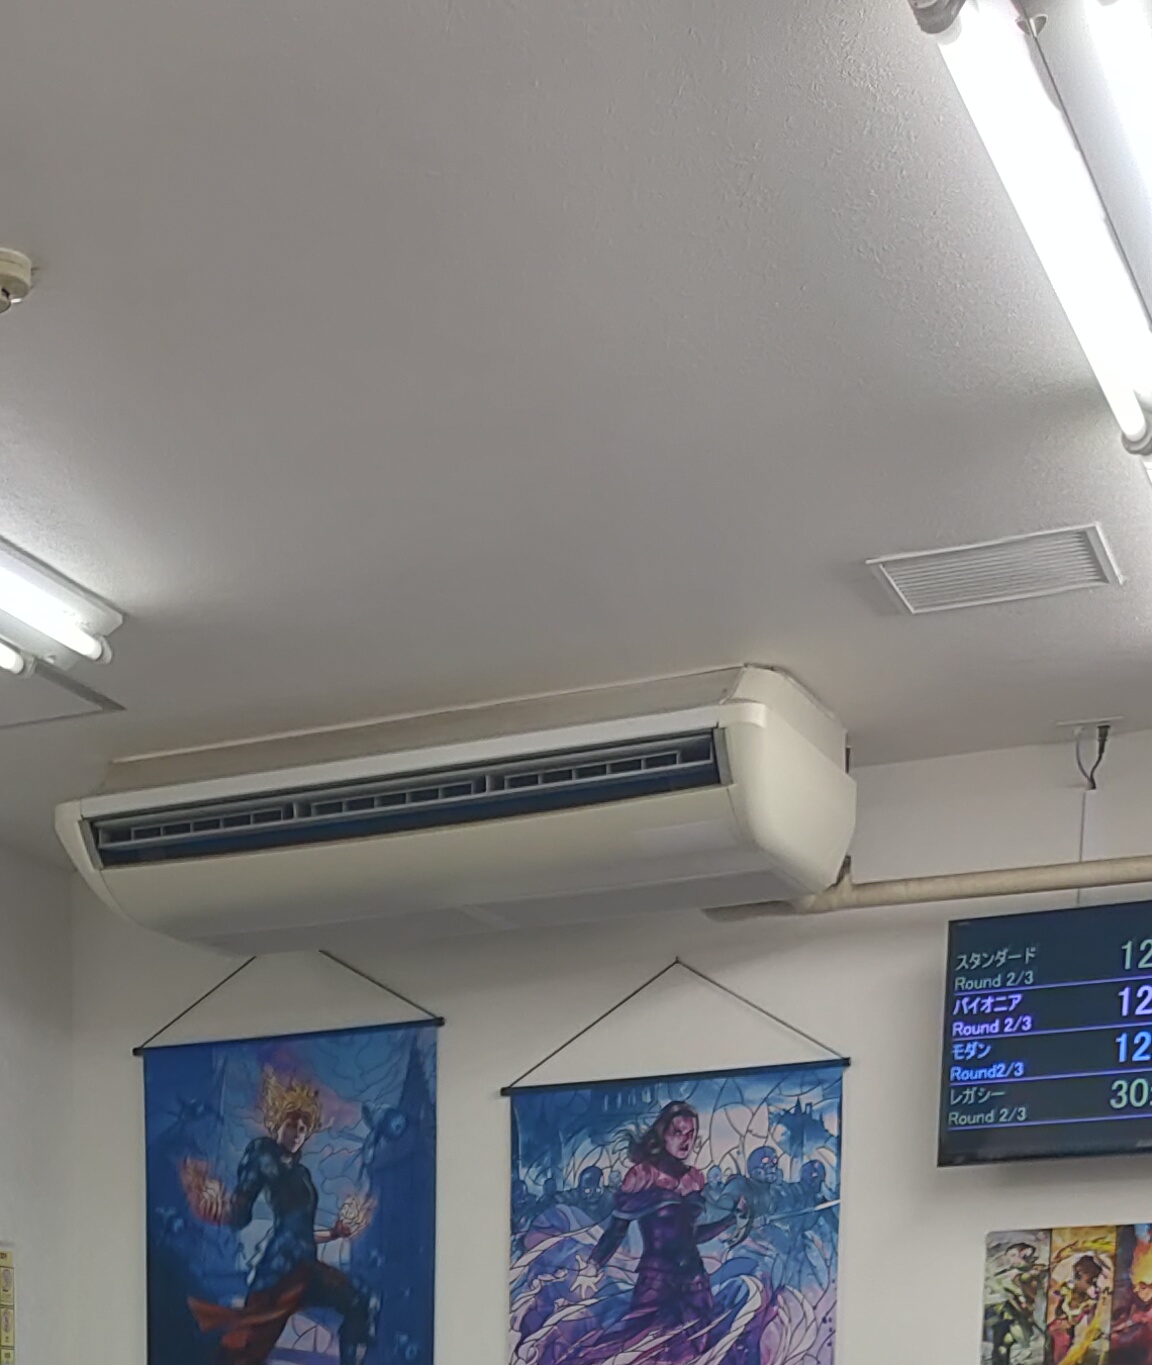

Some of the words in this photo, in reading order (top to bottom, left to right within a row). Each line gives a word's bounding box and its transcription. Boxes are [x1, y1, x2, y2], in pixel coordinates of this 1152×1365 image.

[956, 948, 1036, 970] スタンダード
[954, 977, 1001, 992] Round
[1006, 971, 1035, 987] 2/3
[953, 995, 1022, 1015] パイオニア
[952, 1020, 1000, 1037] Round
[1004, 1016, 1033, 1032] 2/3
[952, 1042, 991, 1061] モダン
[951, 1063, 1024, 1081] Round2/3
[950, 1088, 1006, 1106] レガシー
[948, 1110, 995, 1126] Round
[999, 1107, 1028, 1123] 2/3
